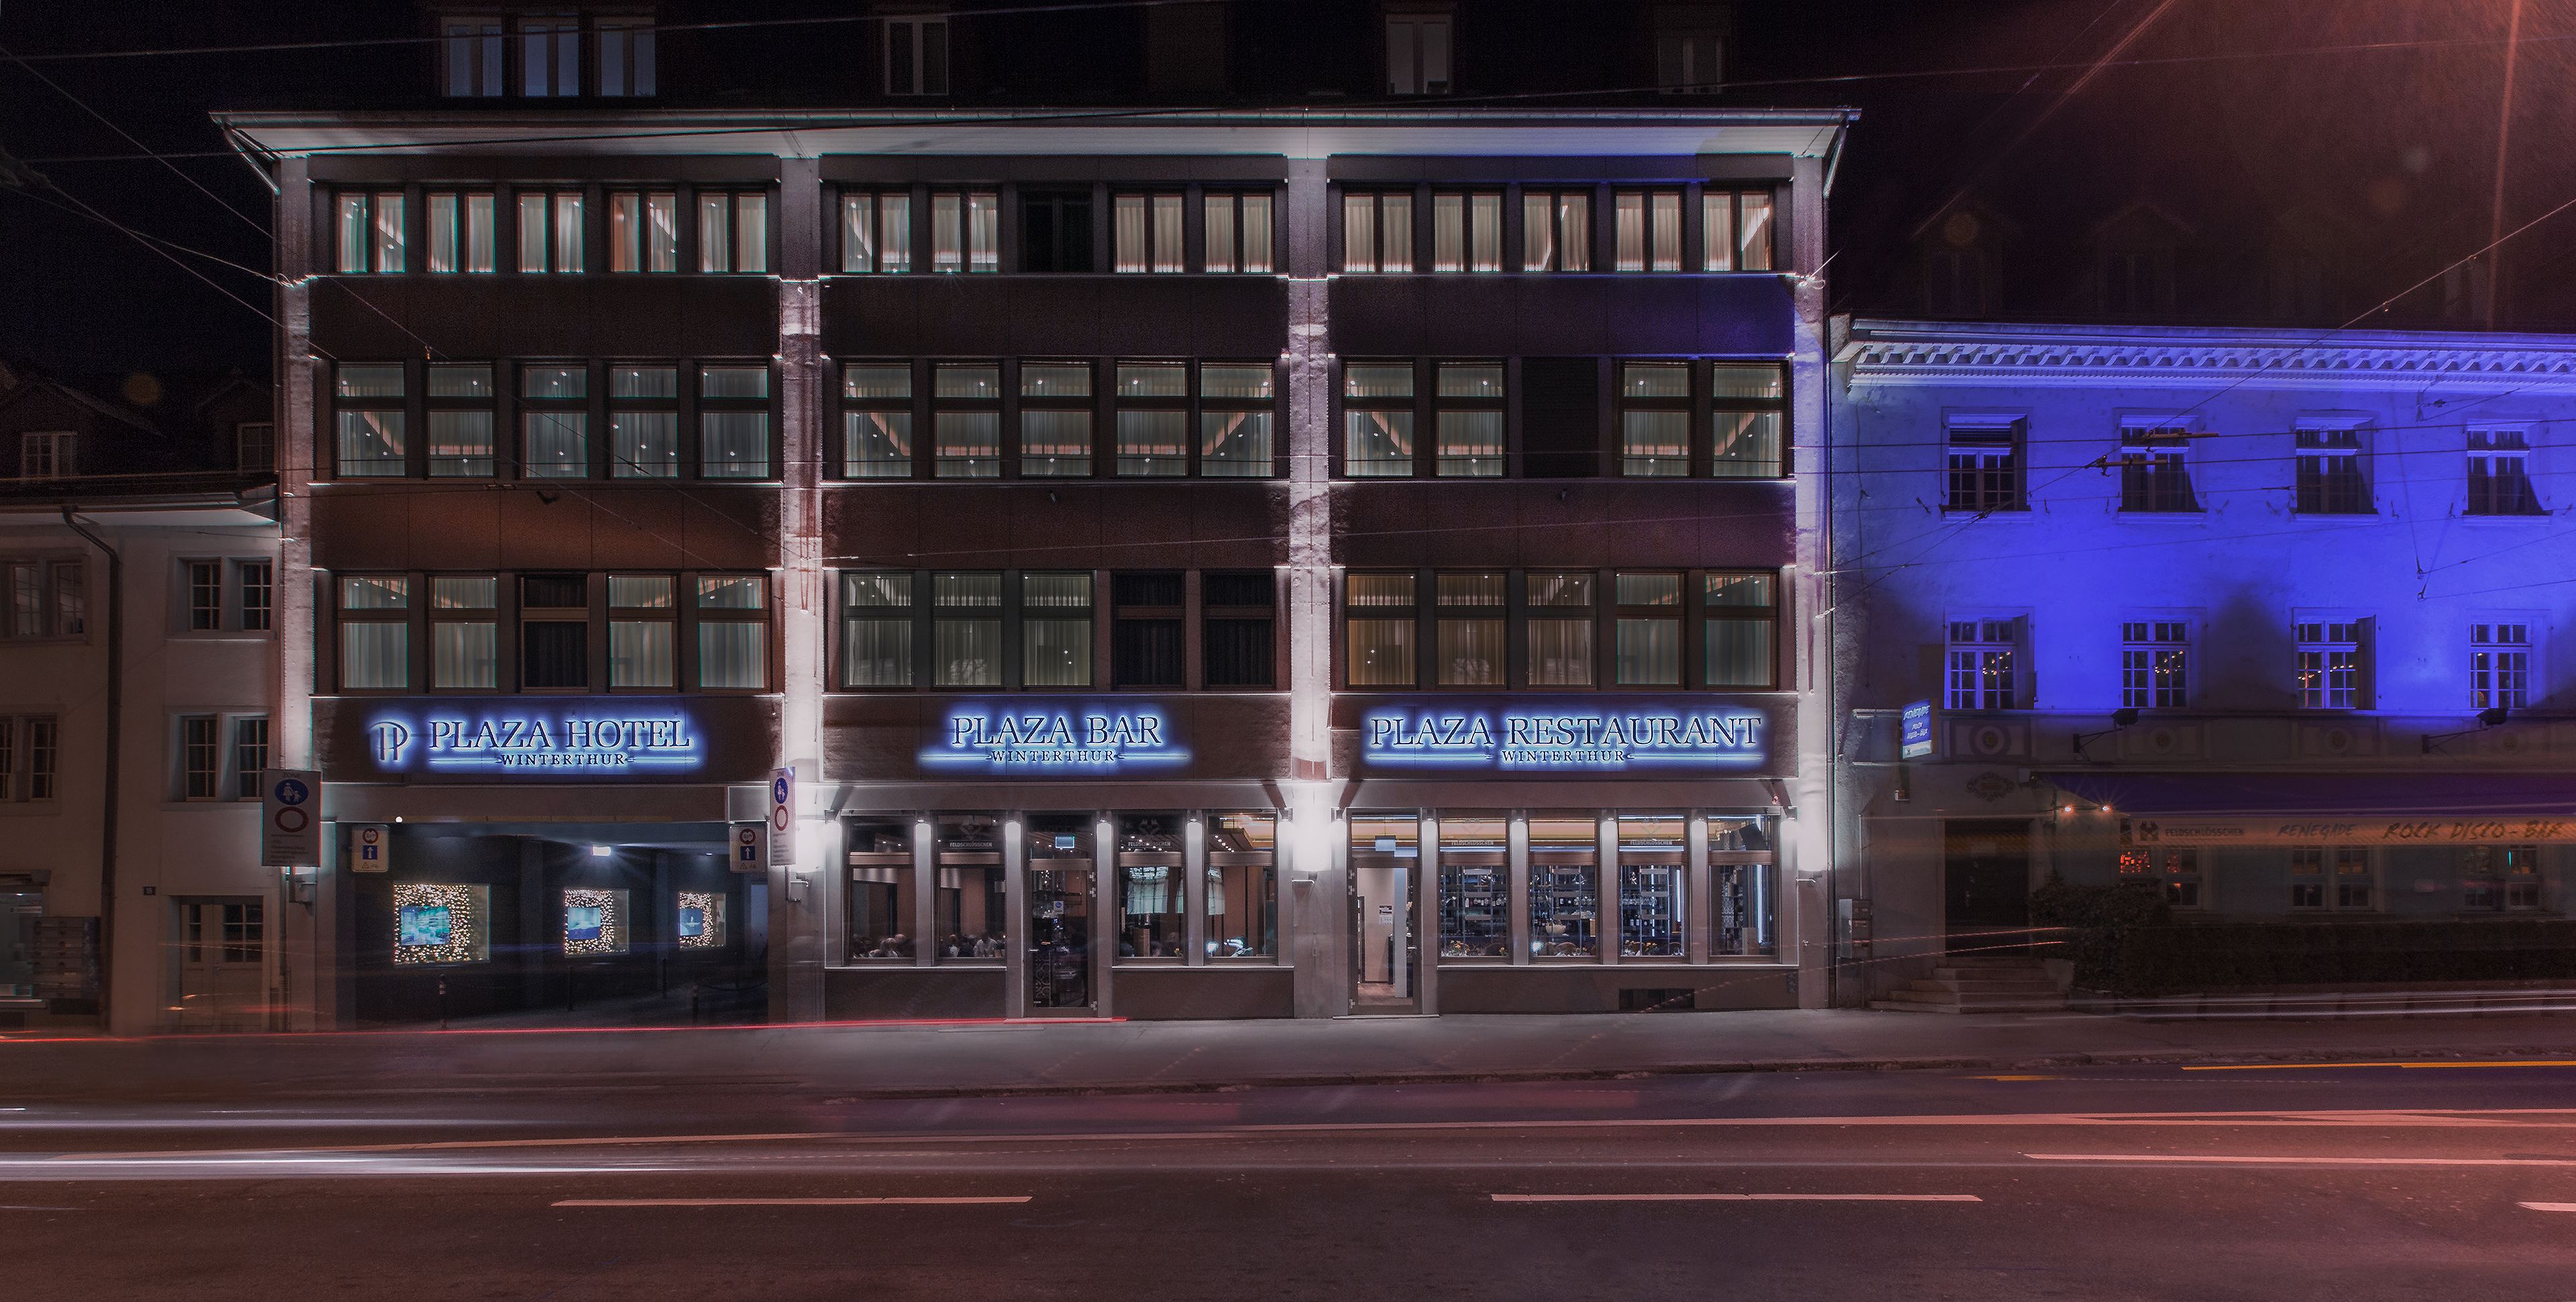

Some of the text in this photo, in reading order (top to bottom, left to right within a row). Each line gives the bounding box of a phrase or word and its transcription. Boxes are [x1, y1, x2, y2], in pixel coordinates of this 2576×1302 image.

[429, 720, 692, 749] PLAZA HOTEL
[952, 716, 1162, 745] PLAZA BAR
[1370, 717, 1762, 746] PLAZA RESTAURANT
[501, 753, 625, 766] WINTERTHUR
[991, 750, 1115, 762] WINTERTHUR
[1502, 750, 1625, 763] WINTERTHUR
[2165, 826, 2245, 837] FELDSCHLÖSSCHEN
[2277, 822, 2357, 839] RENEGADE
[2383, 822, 2442, 839] ROCK
